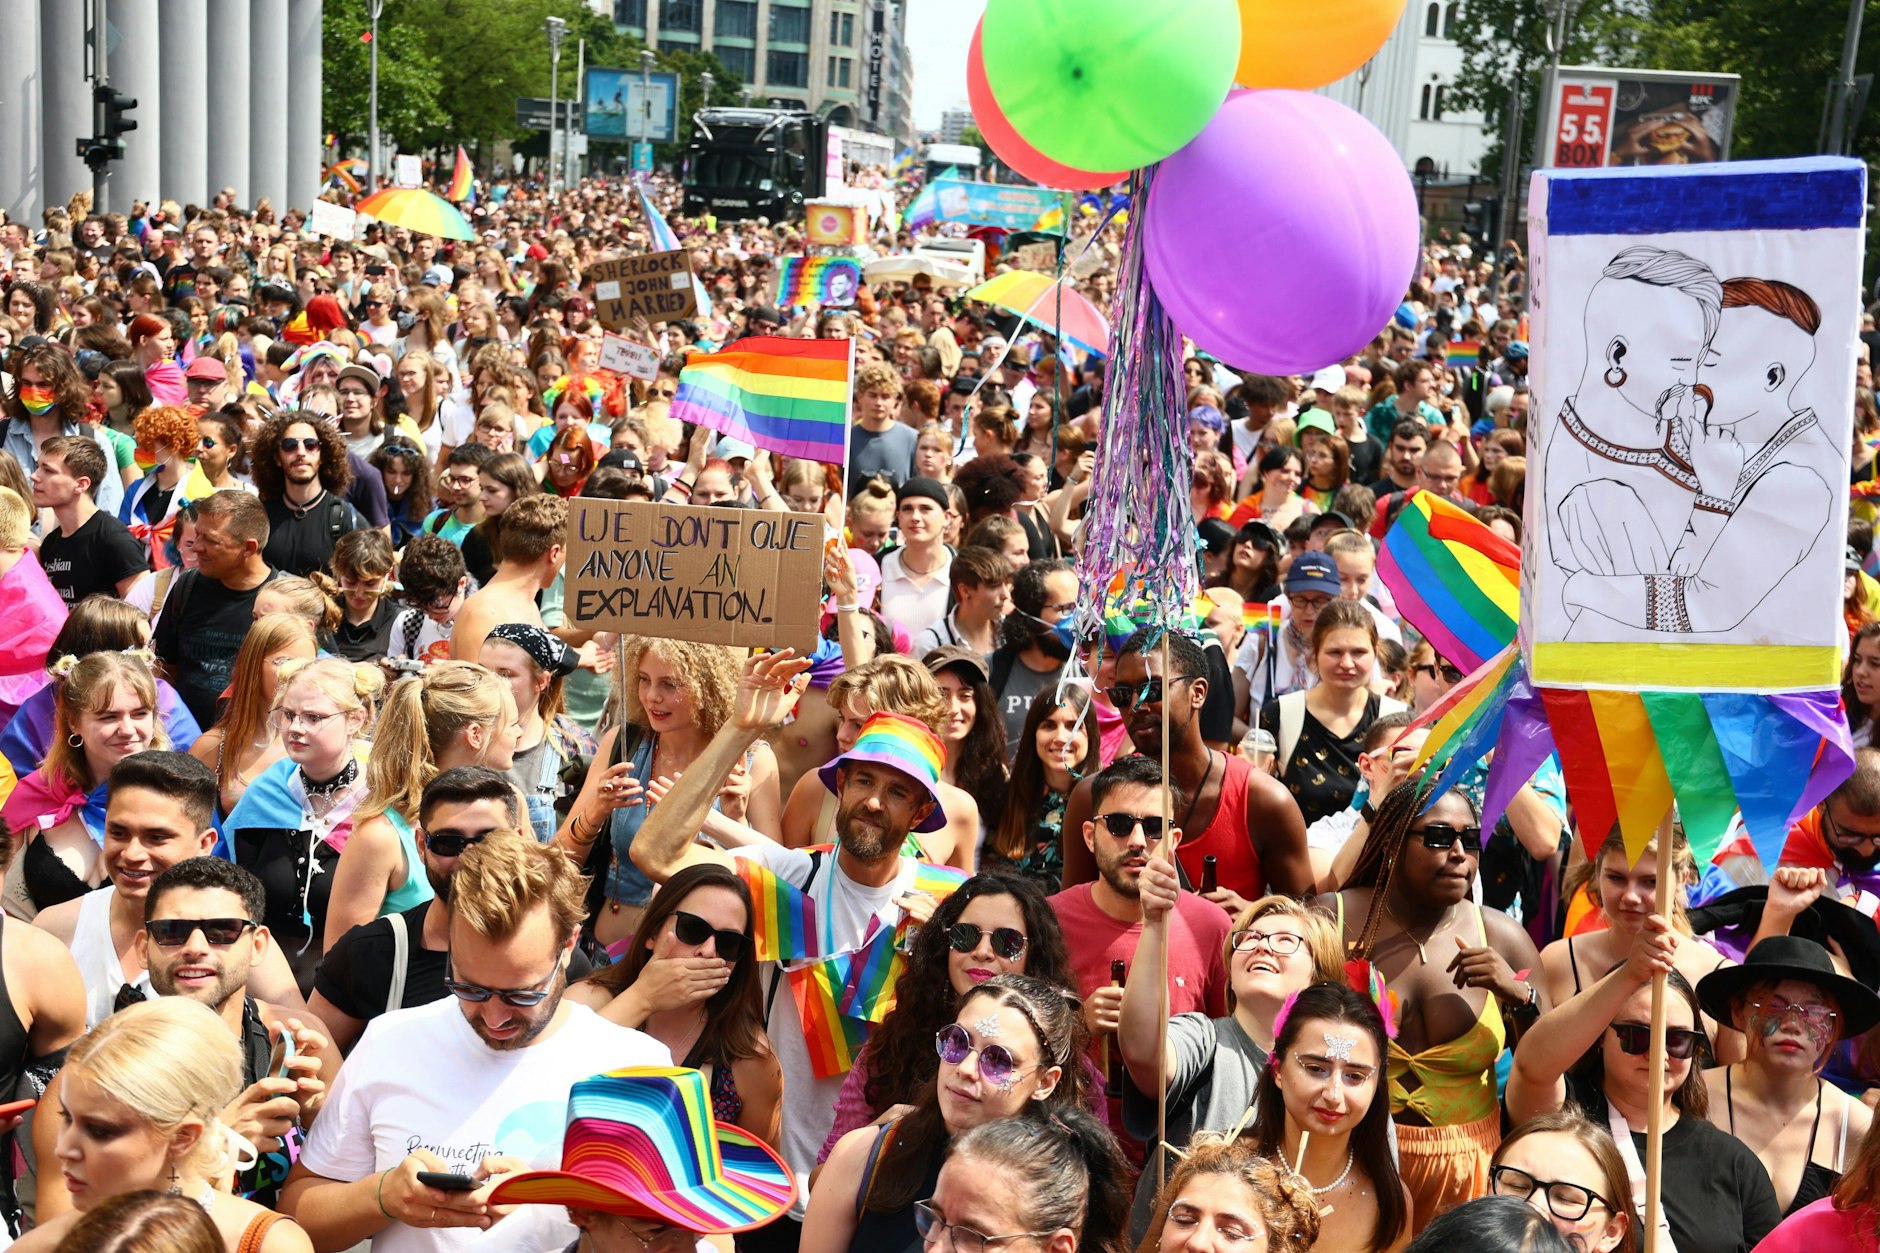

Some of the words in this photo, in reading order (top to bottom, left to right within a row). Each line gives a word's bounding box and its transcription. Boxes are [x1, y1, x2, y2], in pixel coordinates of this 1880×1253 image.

[869, 32, 883, 101] HOTEL
[1558, 143, 1600, 165] BOX
[593, 253, 682, 281] SHERLOCK
[626, 276, 669, 295] JOHN
[610, 292, 685, 321] MARRIED
[579, 508, 633, 543] WE
[651, 515, 740, 548] DON'T
[750, 518, 817, 551] OWE
[44, 558, 72, 573] esbian
[576, 549, 680, 582] ANYONE
[699, 552, 741, 588] AN
[575, 586, 773, 624] EXPLANATION.
